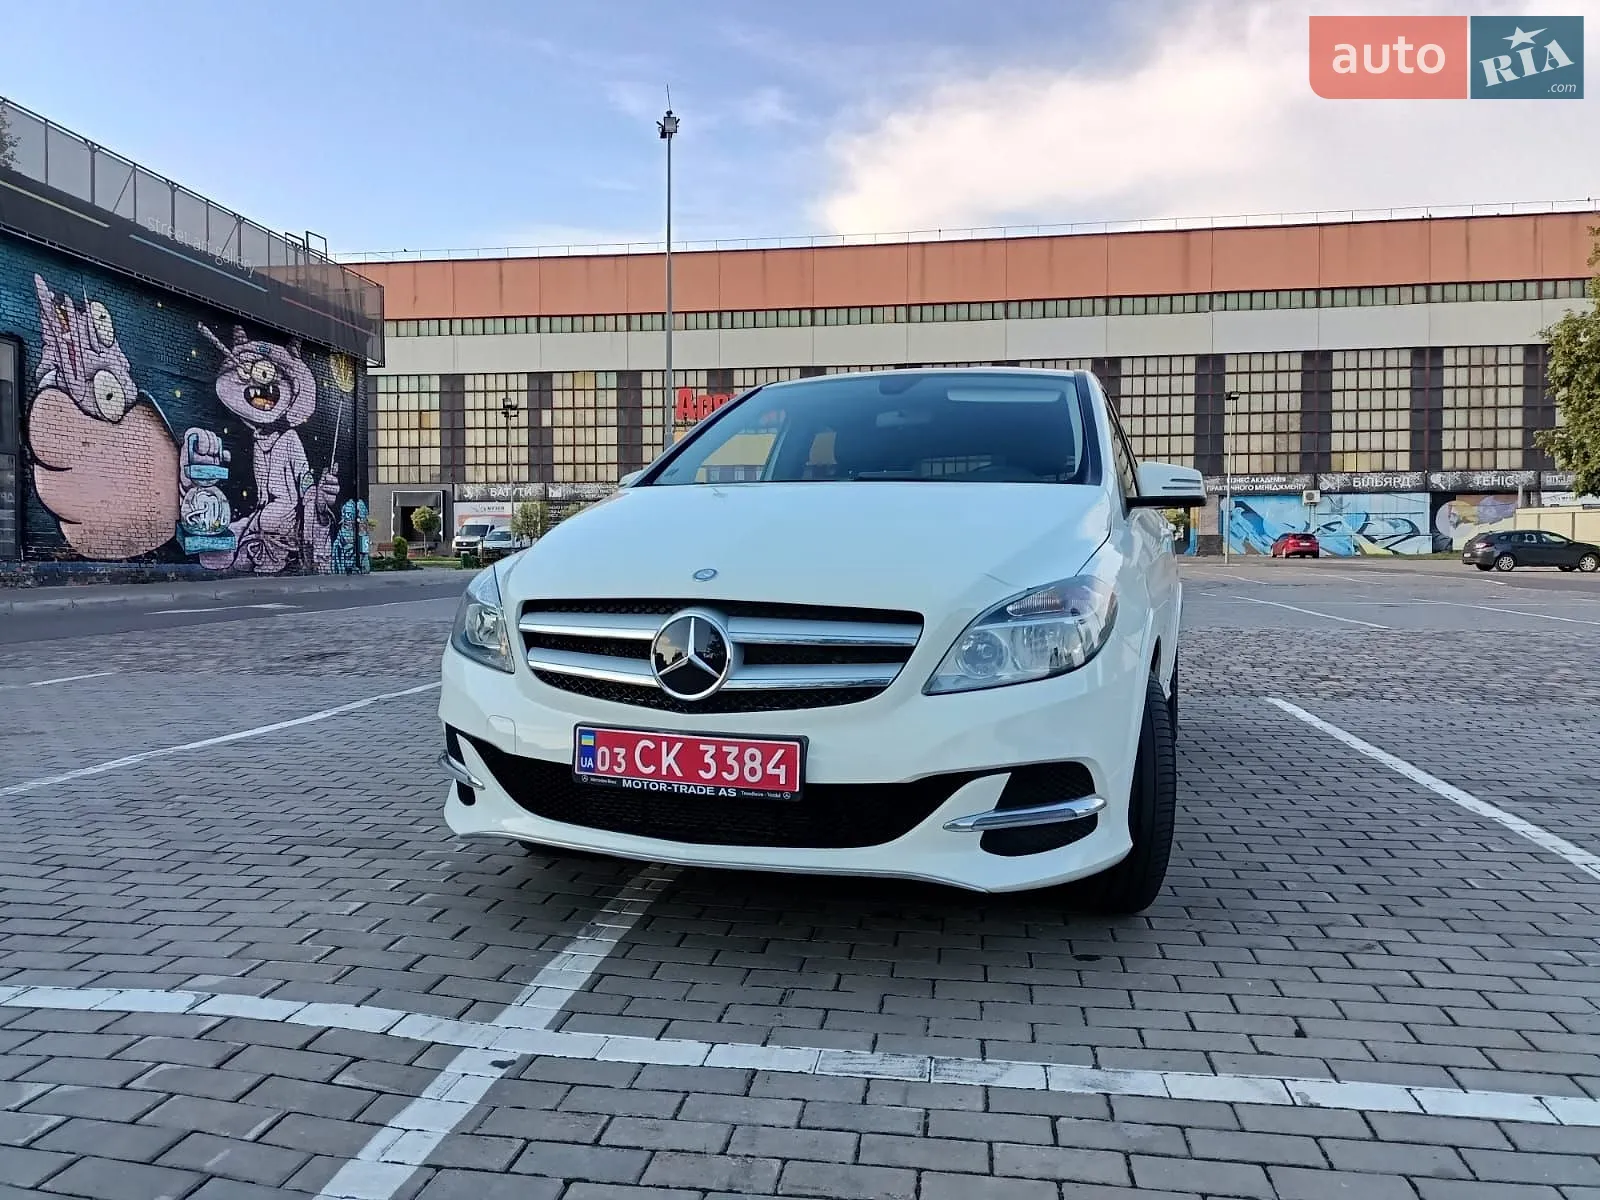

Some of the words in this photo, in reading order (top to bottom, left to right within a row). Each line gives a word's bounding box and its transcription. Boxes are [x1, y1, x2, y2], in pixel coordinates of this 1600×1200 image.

[1476, 475, 1515, 487] ТЕНІС
[580, 756, 594, 769] UA
[597, 746, 627, 774] 03
[698, 744, 787, 785] 3384
[622, 778, 715, 796] MOTOR-TRADE
[718, 787, 737, 797] AS
